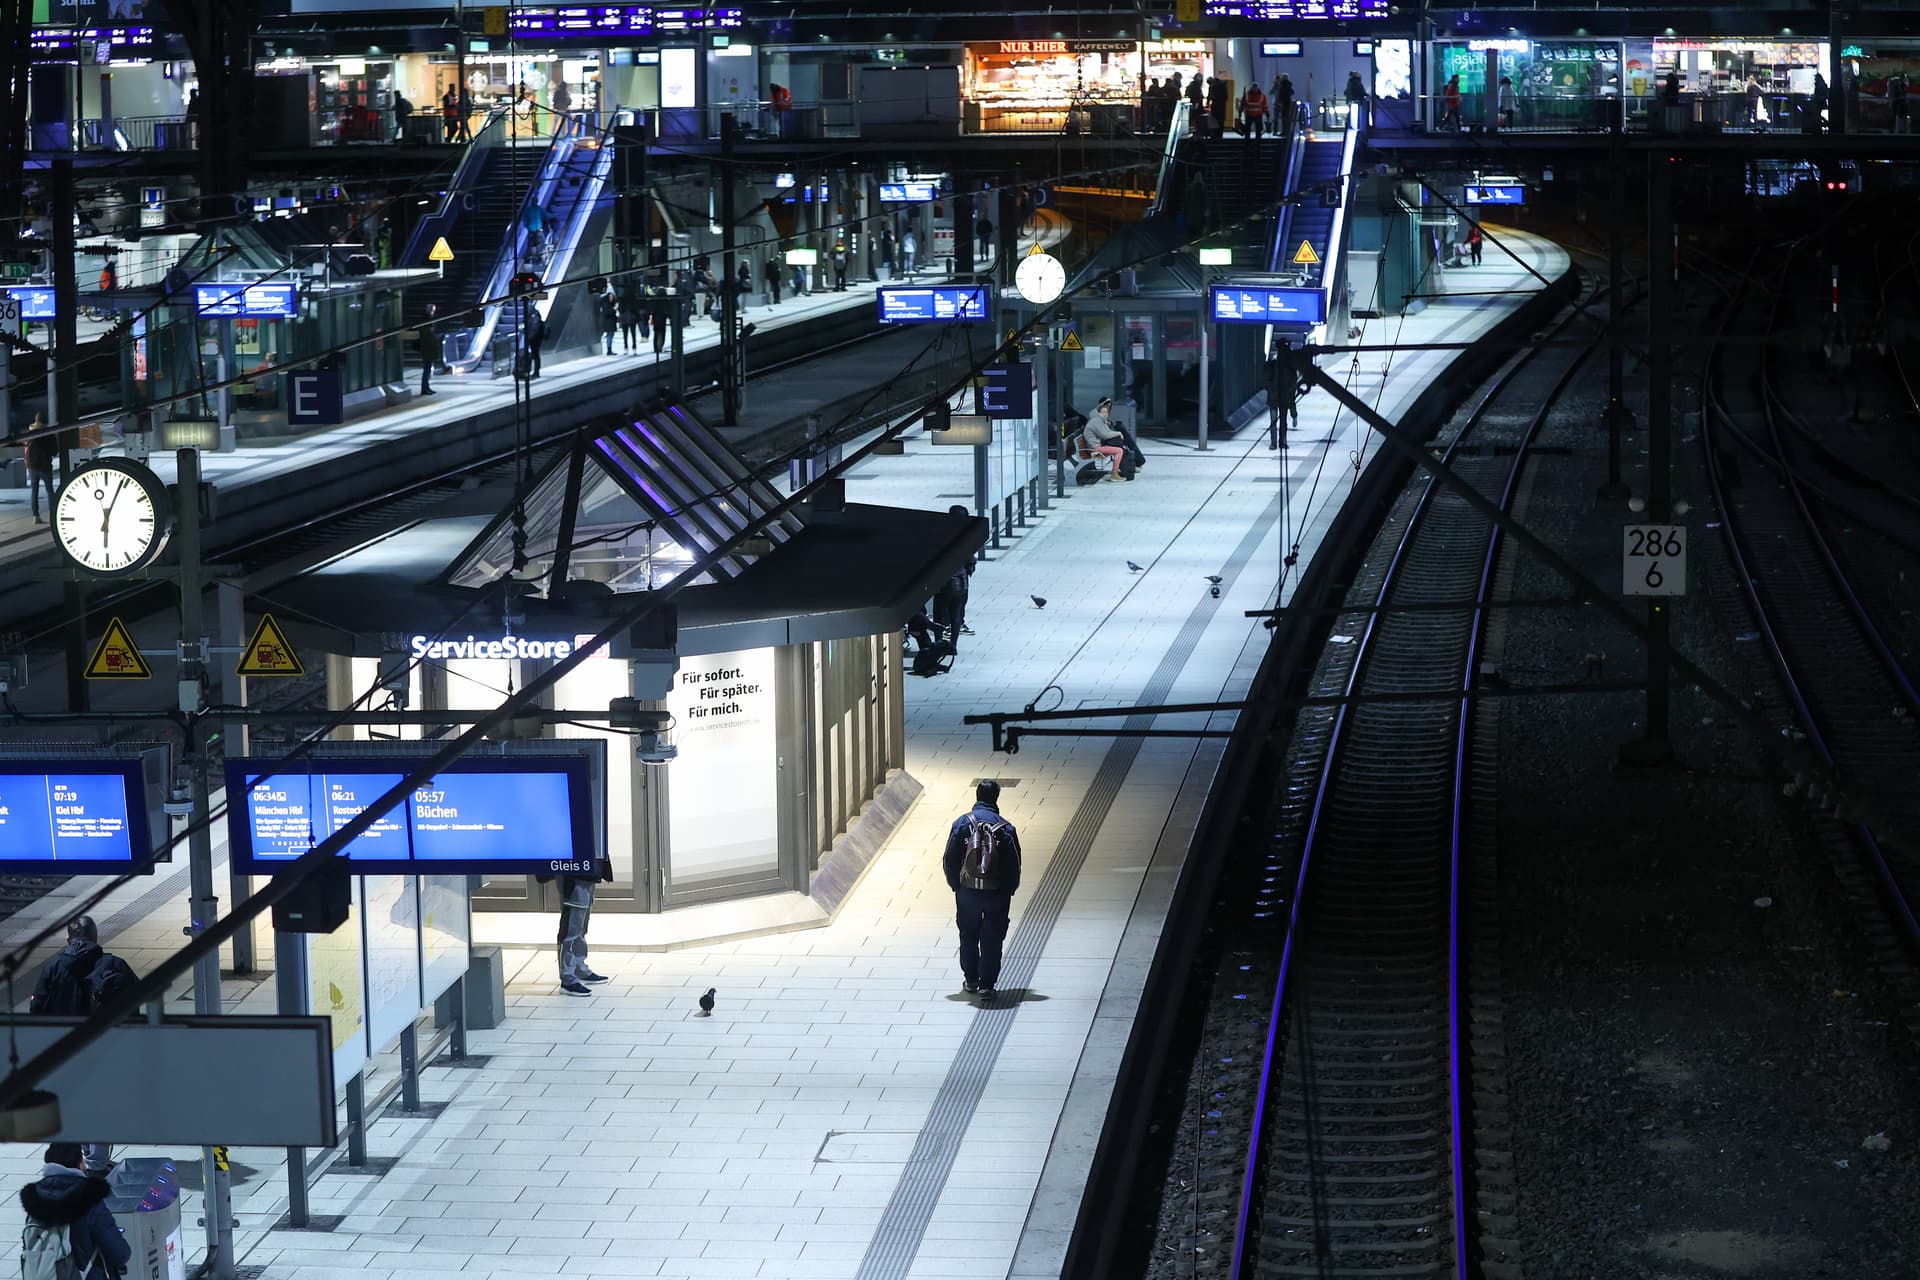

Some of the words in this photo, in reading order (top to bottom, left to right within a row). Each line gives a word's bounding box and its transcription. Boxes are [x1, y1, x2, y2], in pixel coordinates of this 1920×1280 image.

[1168, 14, 1174, 24] 7
[1463, 11, 1470, 22] 8
[1000, 42, 1030, 53] NUR
[1033, 41, 1068, 53] HIER
[1074, 43, 1130, 51] KAFFEEWELT
[294, 376, 320, 416] E
[982, 369, 1009, 411] E
[1628, 529, 1682, 557] 286
[1645, 561, 1663, 588] 6
[411, 635, 571, 659] ServiceStore
[682, 671, 702, 685] Für
[704, 667, 744, 682] sofort.
[700, 686, 720, 700] Für
[722, 683, 762, 699] später.
[689, 705, 709, 719] Für
[711, 701, 743, 716] mich.
[54, 792, 77, 801] 07:19
[254, 791, 277, 802] 06:34
[331, 791, 355, 801] 06:21
[415, 791, 445, 803] 05:57
[56, 805, 70, 815] Kiel
[70, 805, 84, 815] Hbf
[255, 805, 289, 815] München
[289, 805, 303, 815] Hbf
[333, 805, 362, 815] Rostock
[416, 805, 458, 819] Büchen
[550, 860, 580, 871] Gleis
[582, 860, 591, 871] 8
